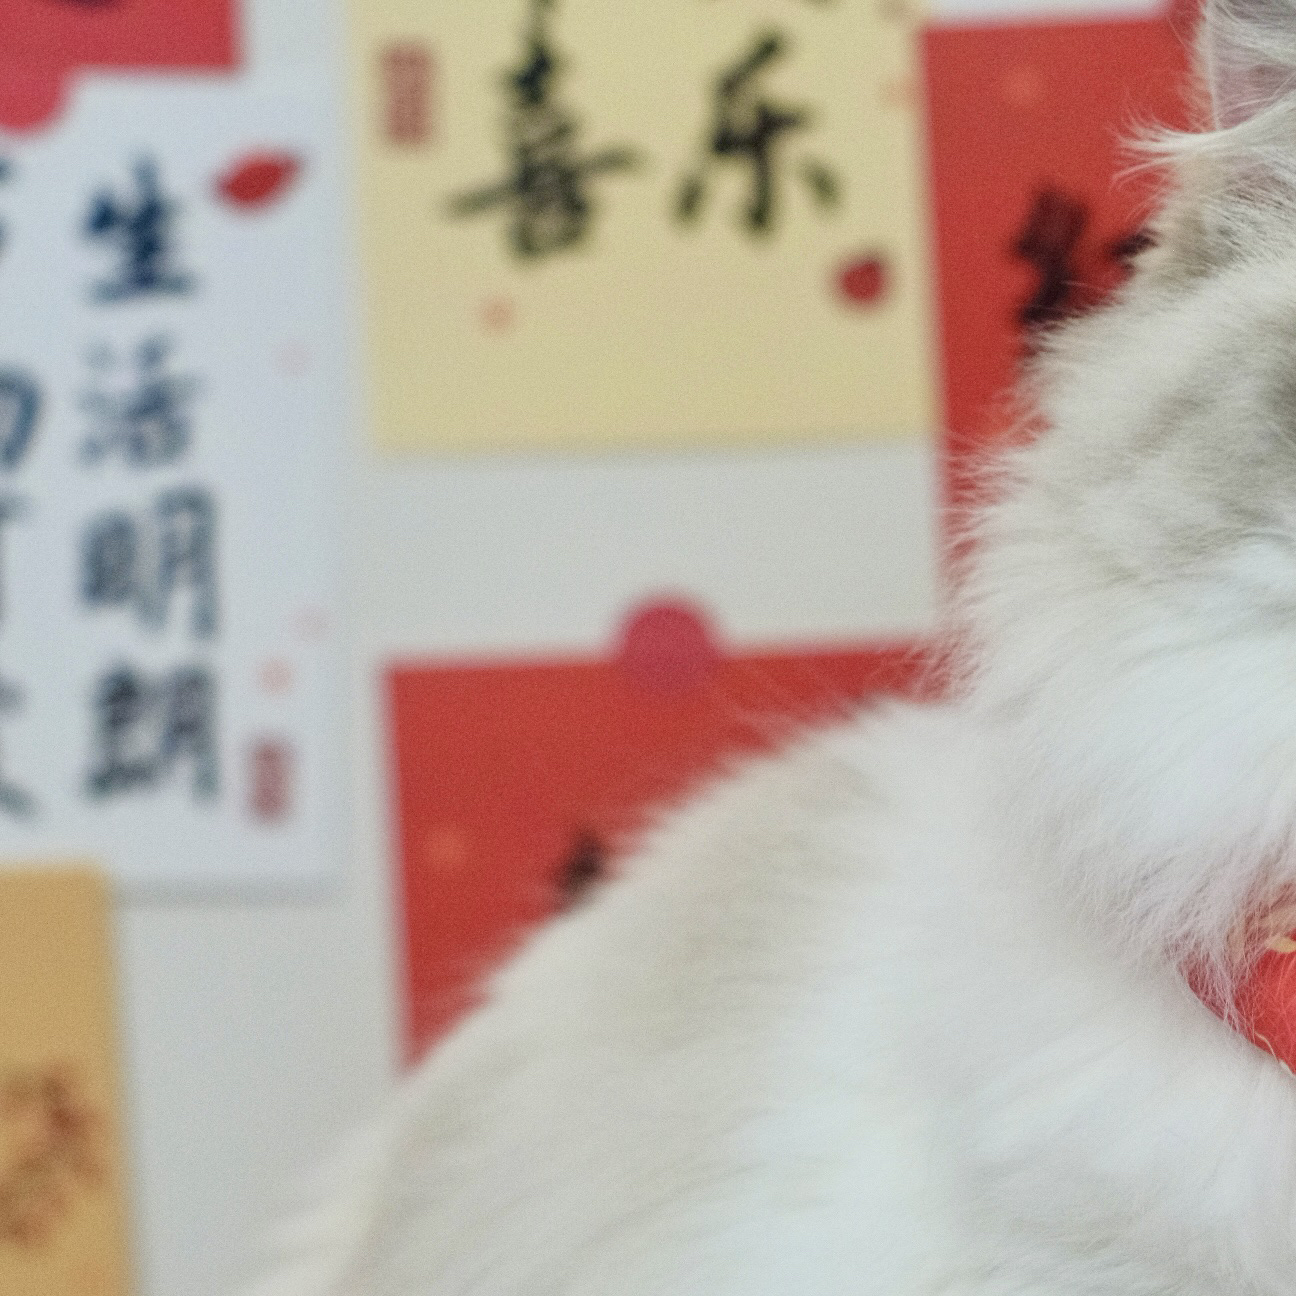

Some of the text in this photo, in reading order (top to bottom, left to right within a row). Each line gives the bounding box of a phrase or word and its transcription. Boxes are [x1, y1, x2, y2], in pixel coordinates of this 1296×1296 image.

[448, 30, 842, 262] 喜乐
[76, 152, 222, 806] 生活明朗
